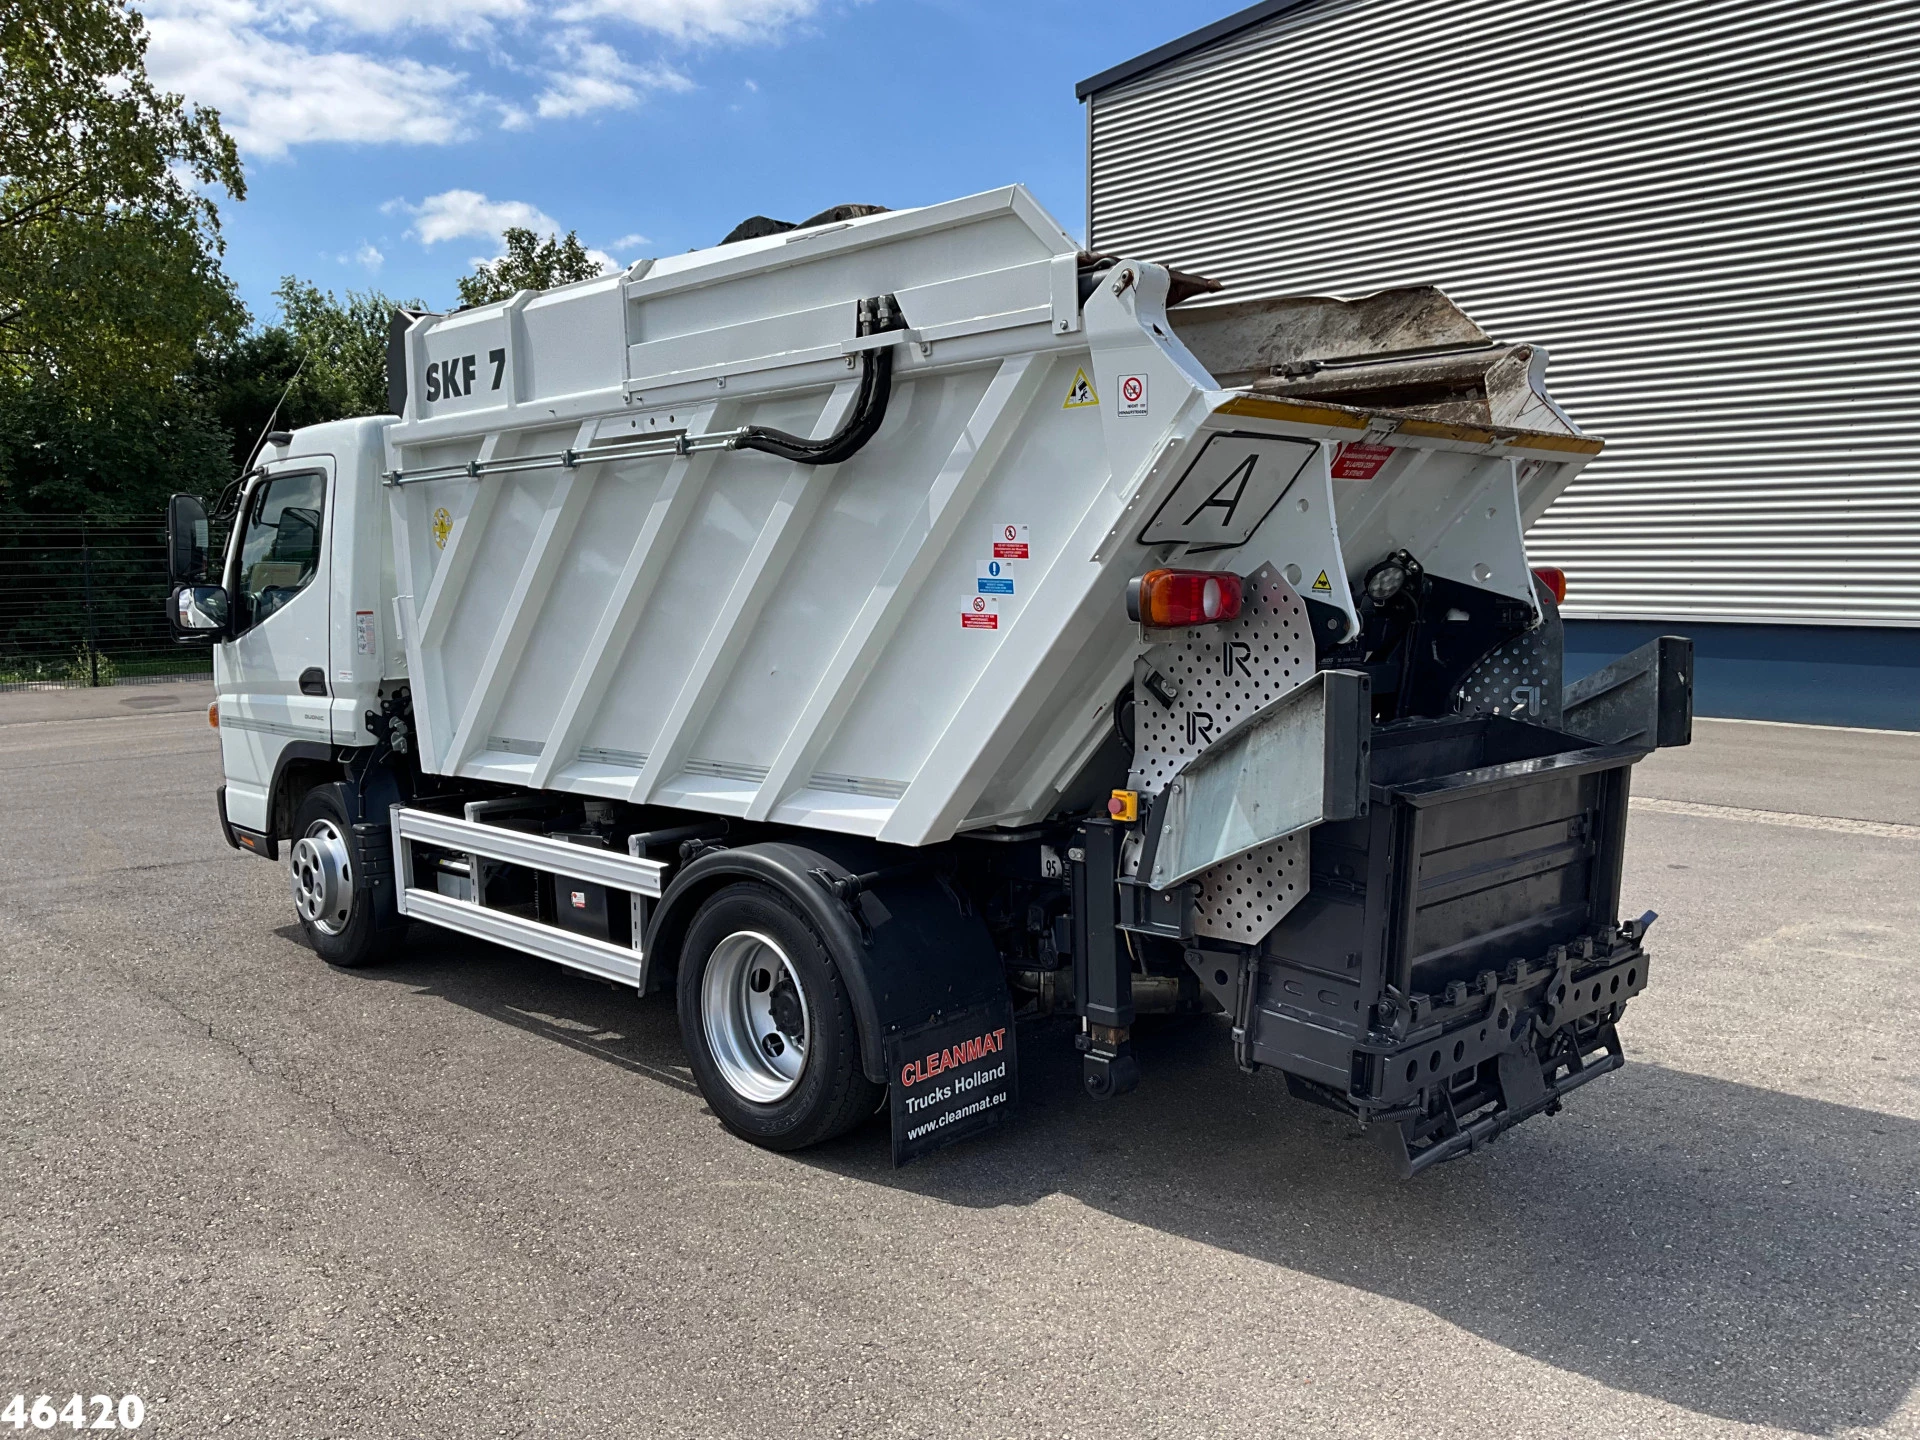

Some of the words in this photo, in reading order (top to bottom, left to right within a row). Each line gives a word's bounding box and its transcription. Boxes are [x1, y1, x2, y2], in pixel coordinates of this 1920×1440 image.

[426, 354, 476, 402] SKF
[489, 348, 505, 391] 7
[1182, 454, 1259, 526] A
[1046, 859, 1056, 877] 95
[901, 1027, 1006, 1087] CLEANMAT
[905, 1087, 951, 1114] Trucks
[954, 1061, 1006, 1094] Holland
[907, 1091, 1007, 1140] www.cleanmat.eu
